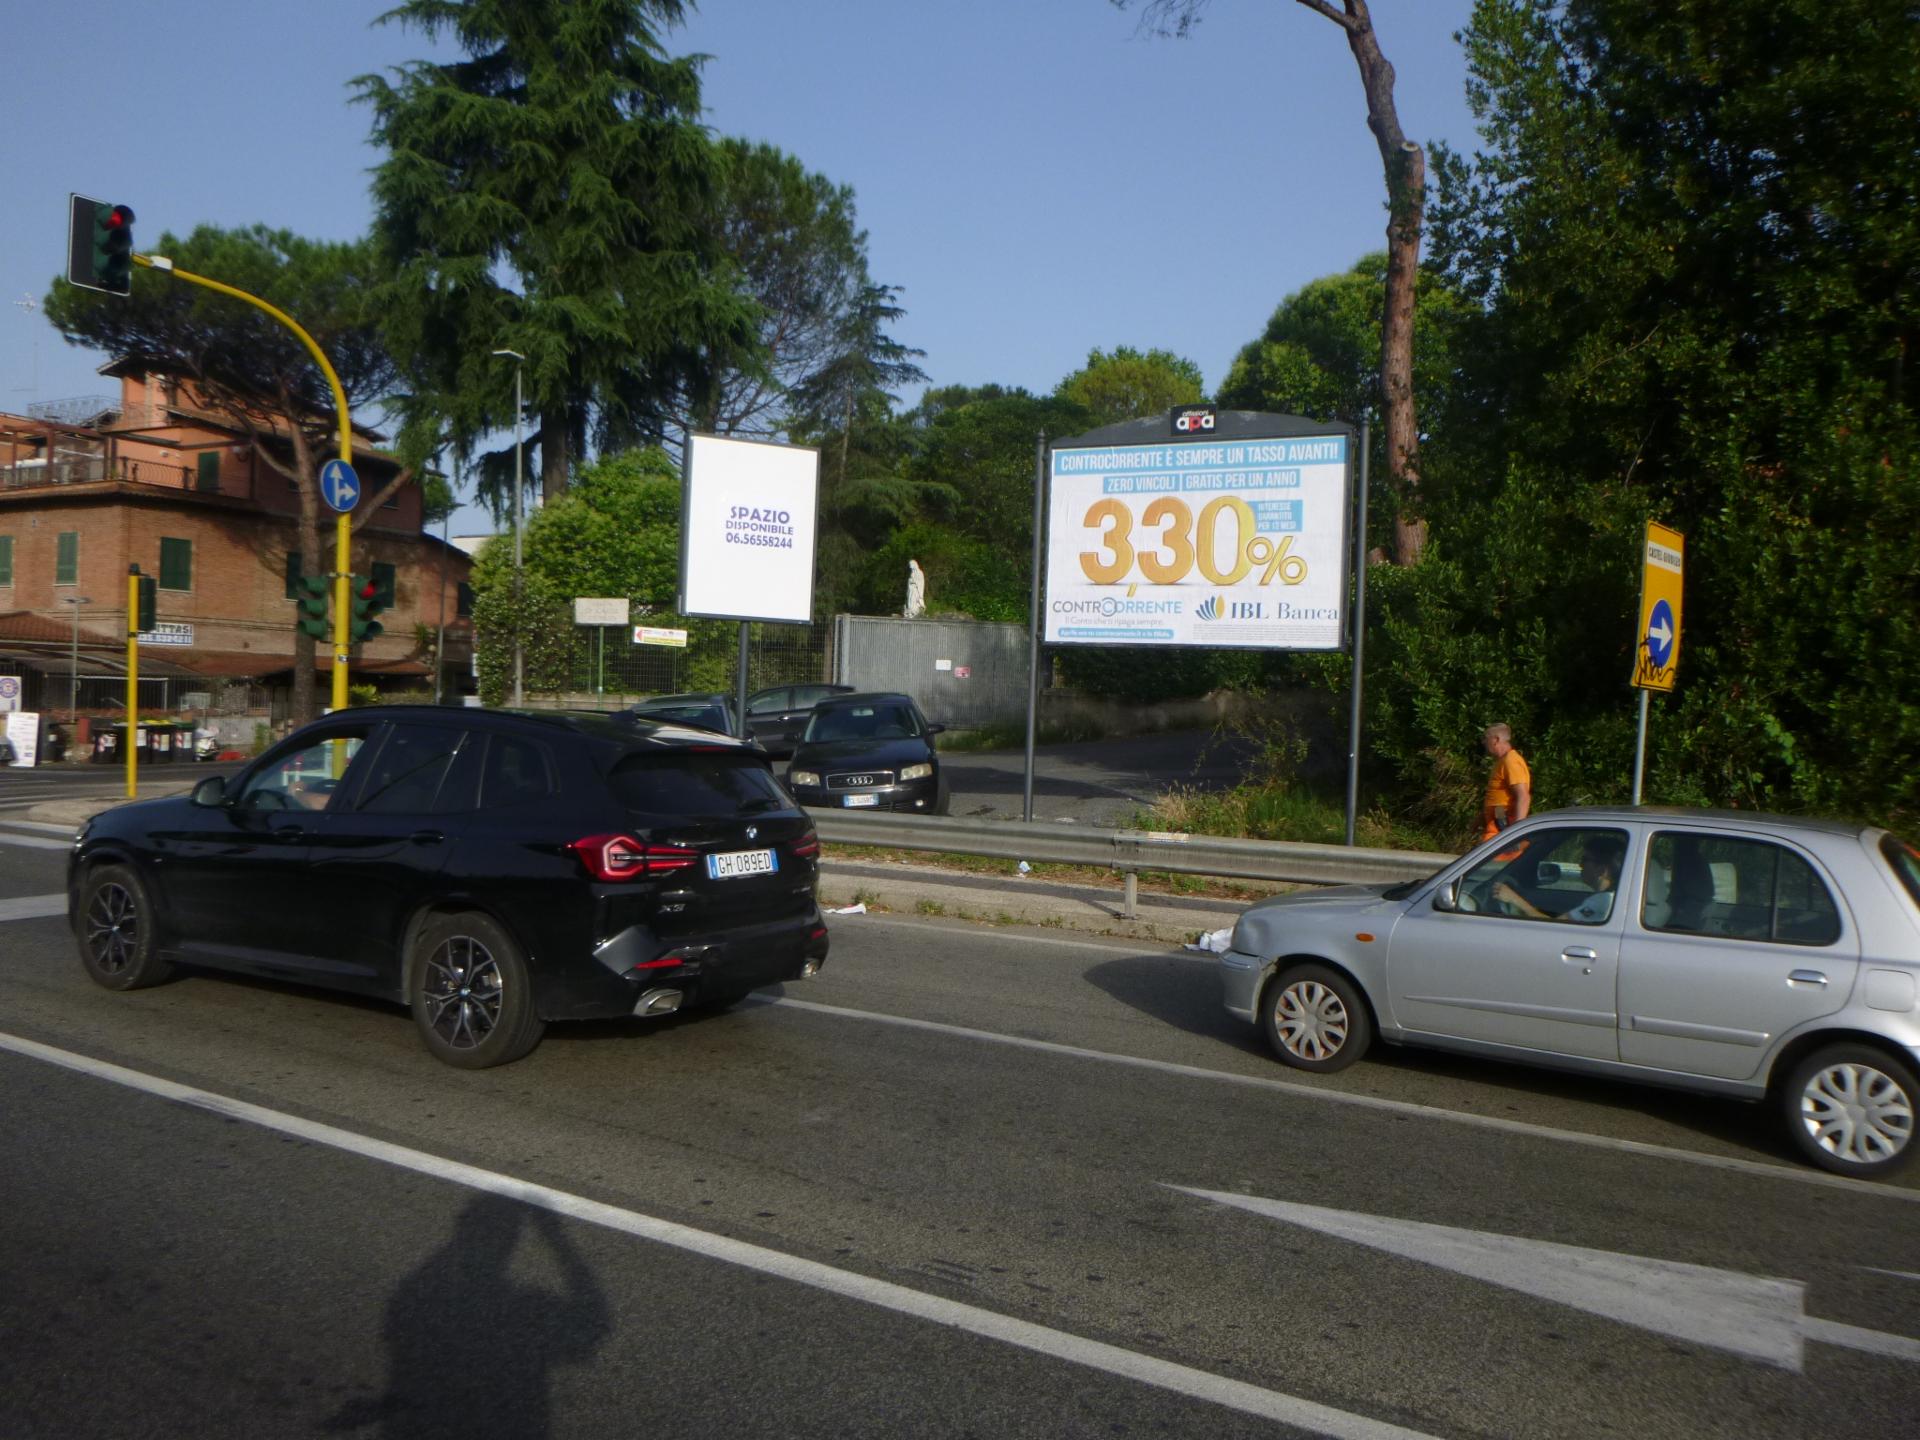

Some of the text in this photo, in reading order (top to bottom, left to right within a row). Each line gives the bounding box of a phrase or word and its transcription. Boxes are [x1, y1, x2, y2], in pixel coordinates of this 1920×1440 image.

[1176, 415, 1214, 432] apa
[1061, 442, 1338, 471] CONTROCORRENTE È SEMPRE UN TASSO AVANTI!
[1108, 470, 1297, 492] ZERO VINCOLI GRATIS PER UN ANNO
[730, 506, 790, 524] SPAZIO
[725, 520, 793, 535] DISPONIBILE
[726, 533, 792, 548] 06.56558244
[1053, 598, 1183, 616] CONTROCORRENTE
[1231, 602, 1338, 620] IBL Banca
[718, 853, 771, 875] GH 089ED
